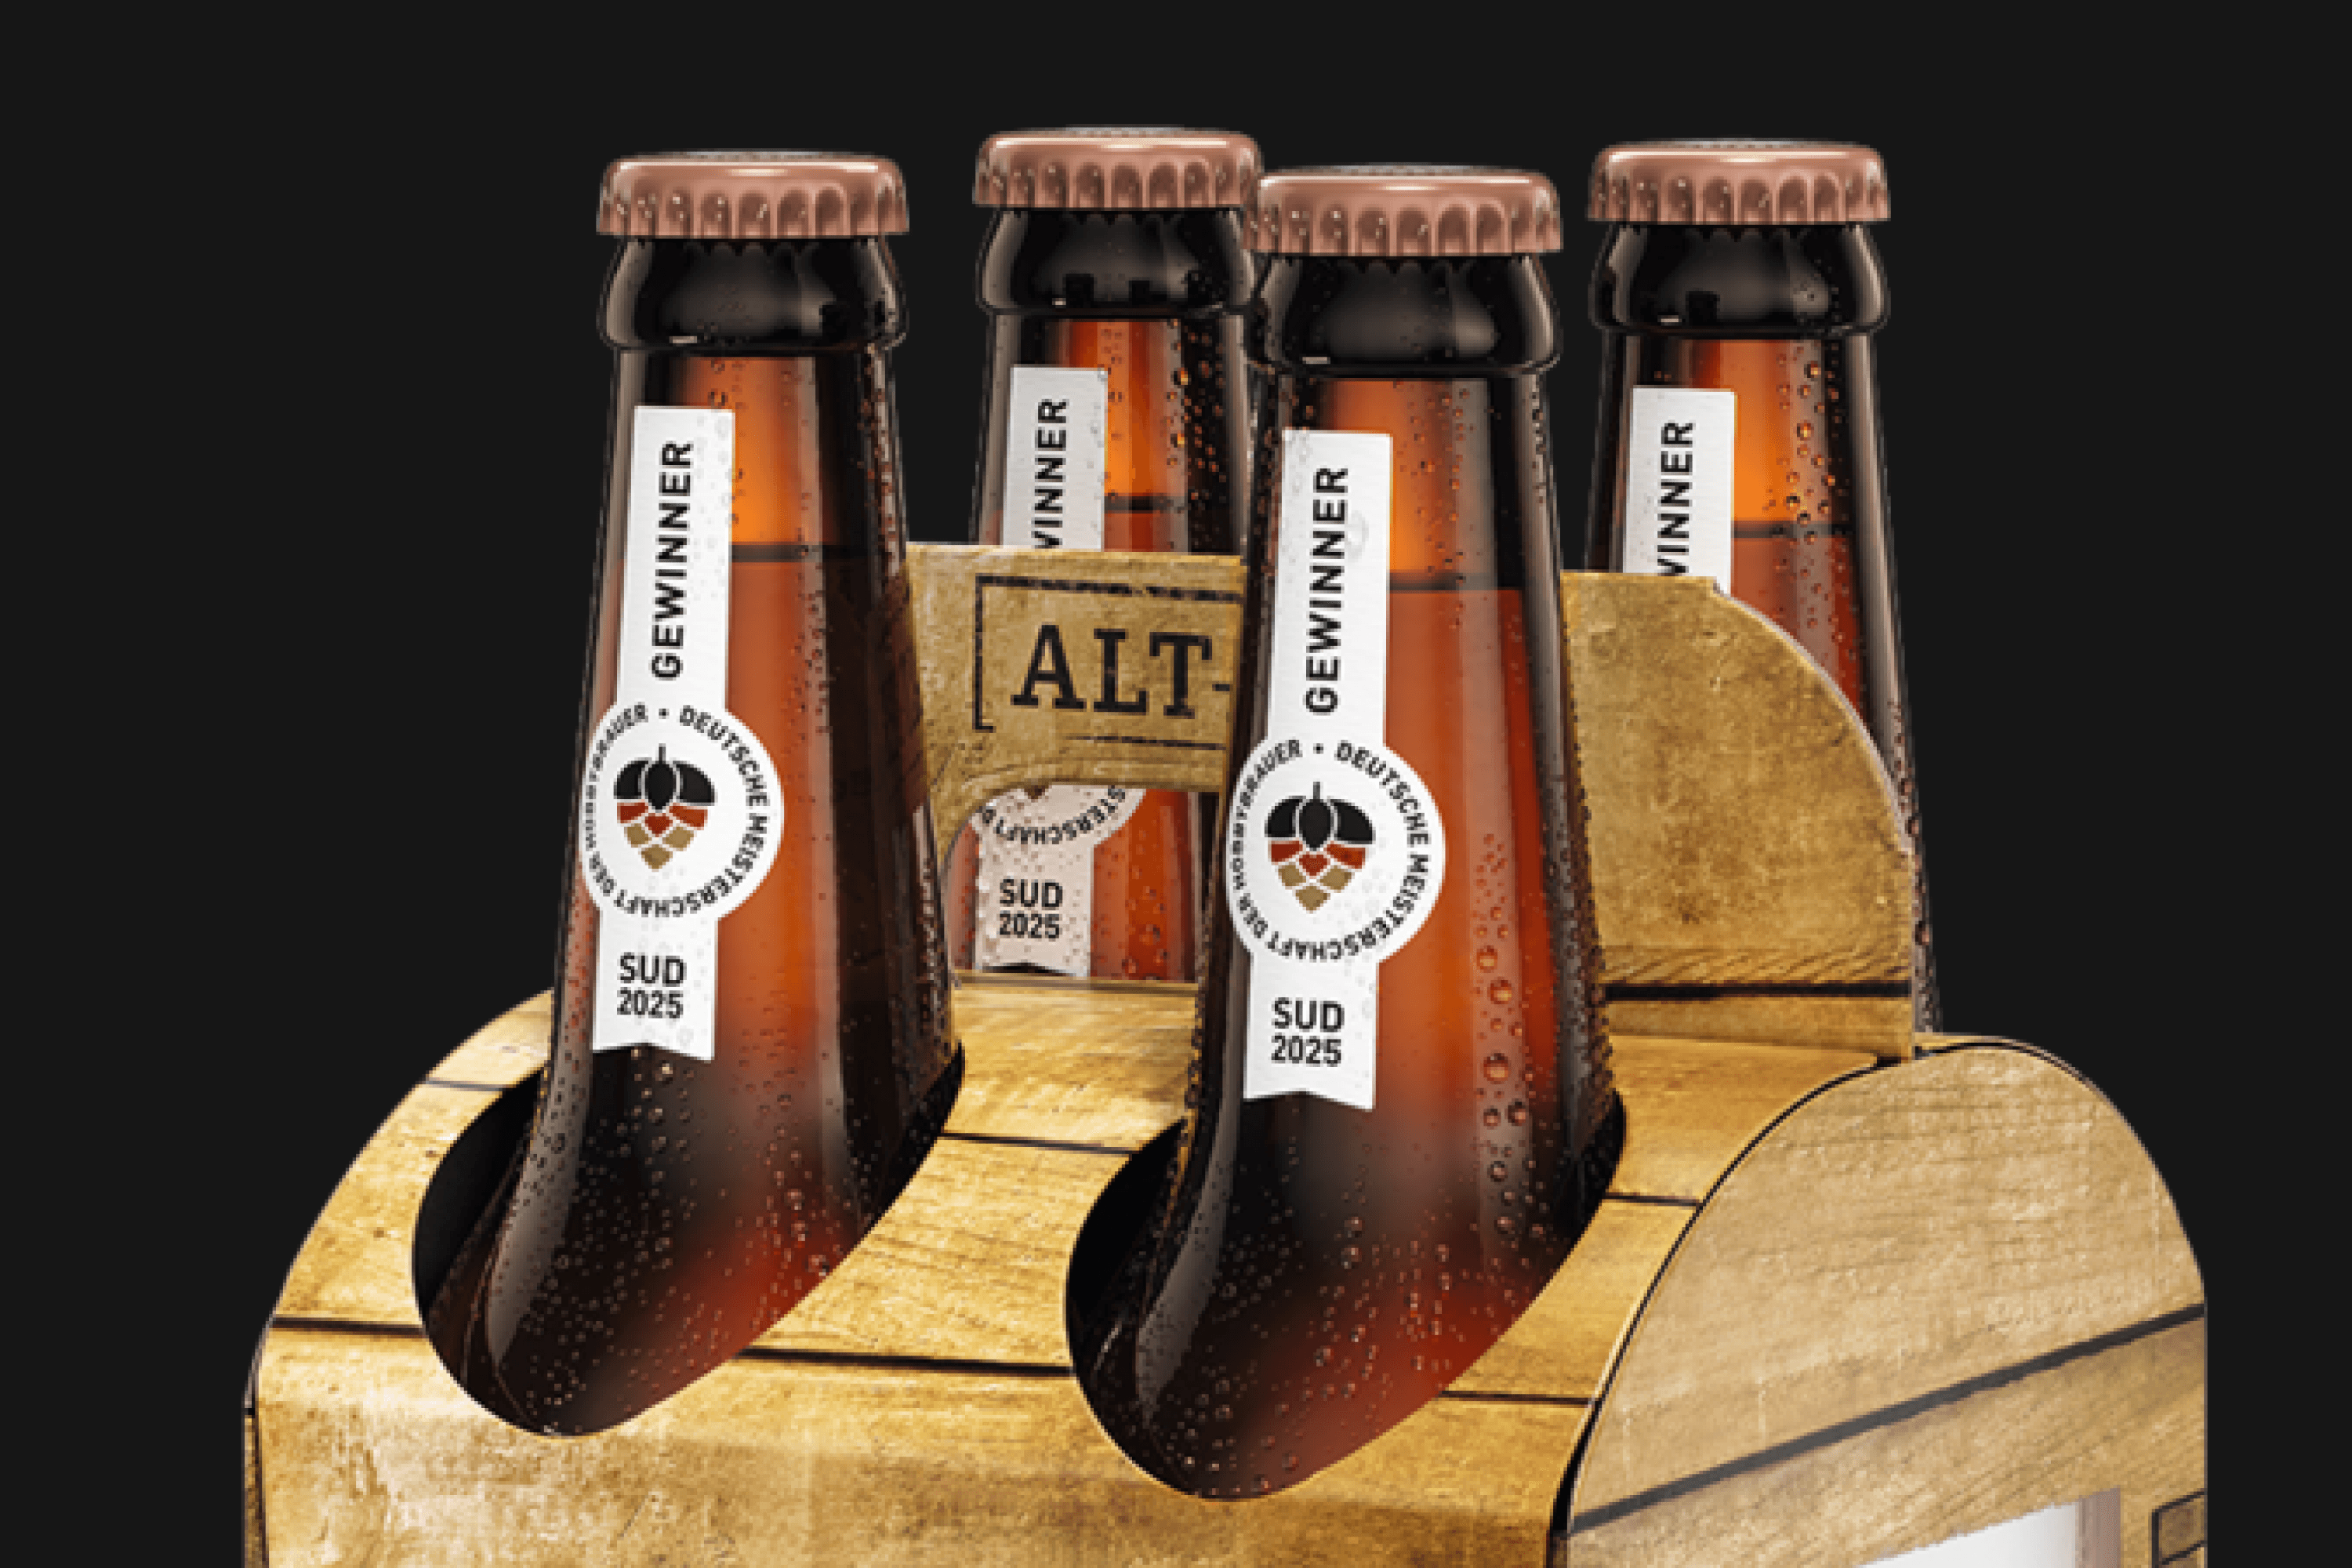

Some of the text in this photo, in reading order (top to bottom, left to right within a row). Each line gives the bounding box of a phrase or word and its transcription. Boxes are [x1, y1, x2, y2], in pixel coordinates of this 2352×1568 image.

[650, 441, 693, 680] GEWINNER
[1304, 466, 1348, 714] GEWINNER
[679, 704, 770, 808] DEUTSCHE
[614, 812, 768, 918] MEISTERSCHAFT
[1231, 739, 1430, 962] DEUTSCHE MEISTERSCHAFT DER HOBBYBRAUER
[588, 851, 616, 896] DER
[999, 877, 1063, 910] SUD
[999, 910, 1061, 940] 2025
[619, 952, 686, 986] SUD
[616, 986, 684, 1019] 2025
[1272, 996, 1345, 1033] SUD
[1271, 1033, 1342, 1067] 2025
